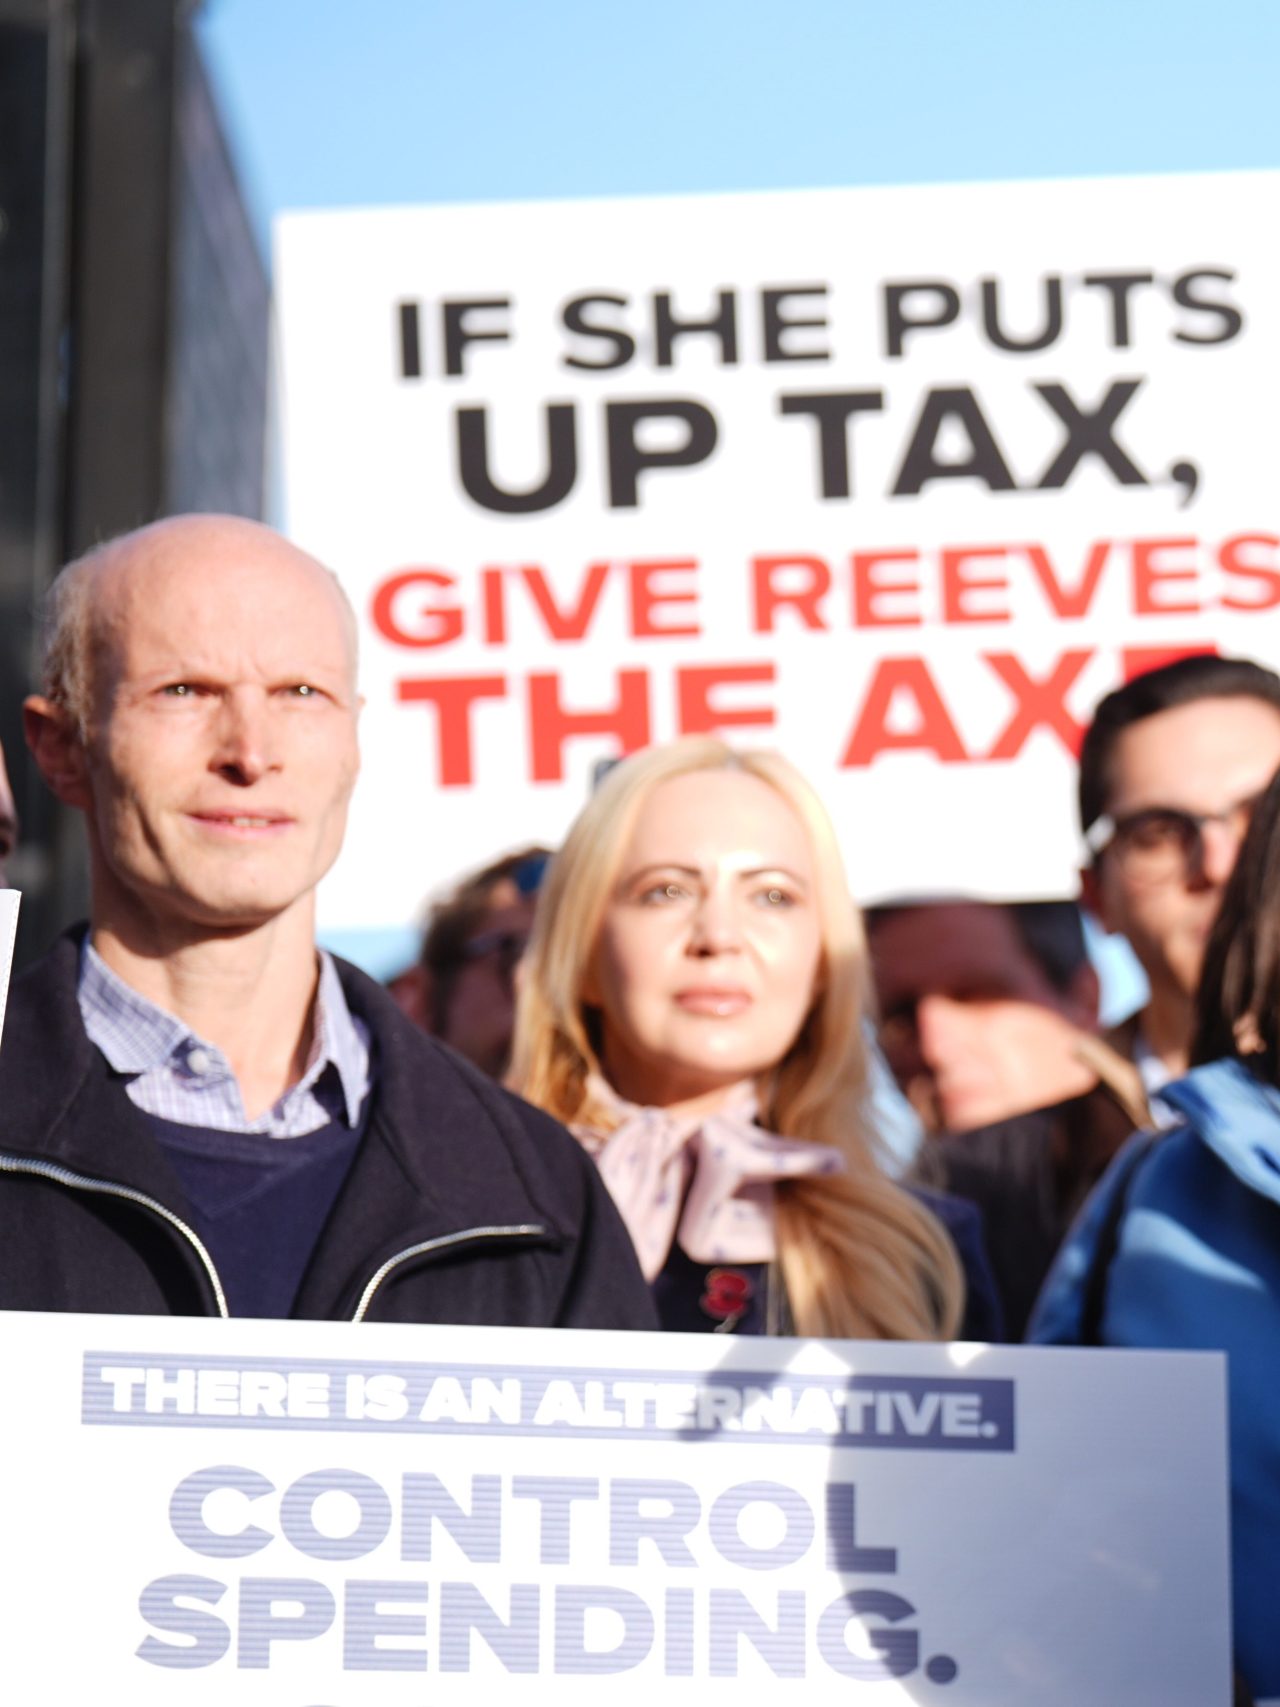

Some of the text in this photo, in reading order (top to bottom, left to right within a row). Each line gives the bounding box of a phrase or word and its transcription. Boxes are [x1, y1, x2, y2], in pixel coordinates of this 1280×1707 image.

[398, 268, 1245, 379] IF SHE PUTS
[455, 378, 1201, 515] UP TAX,
[370, 559, 701, 649] GIVE
[397, 643, 1218, 788] THE AX
[100, 1366, 999, 1440] THERE IS AN ALTERNATIVE.
[168, 1464, 897, 1574] CONTROL
[135, 1574, 957, 1685] SPENDING.
